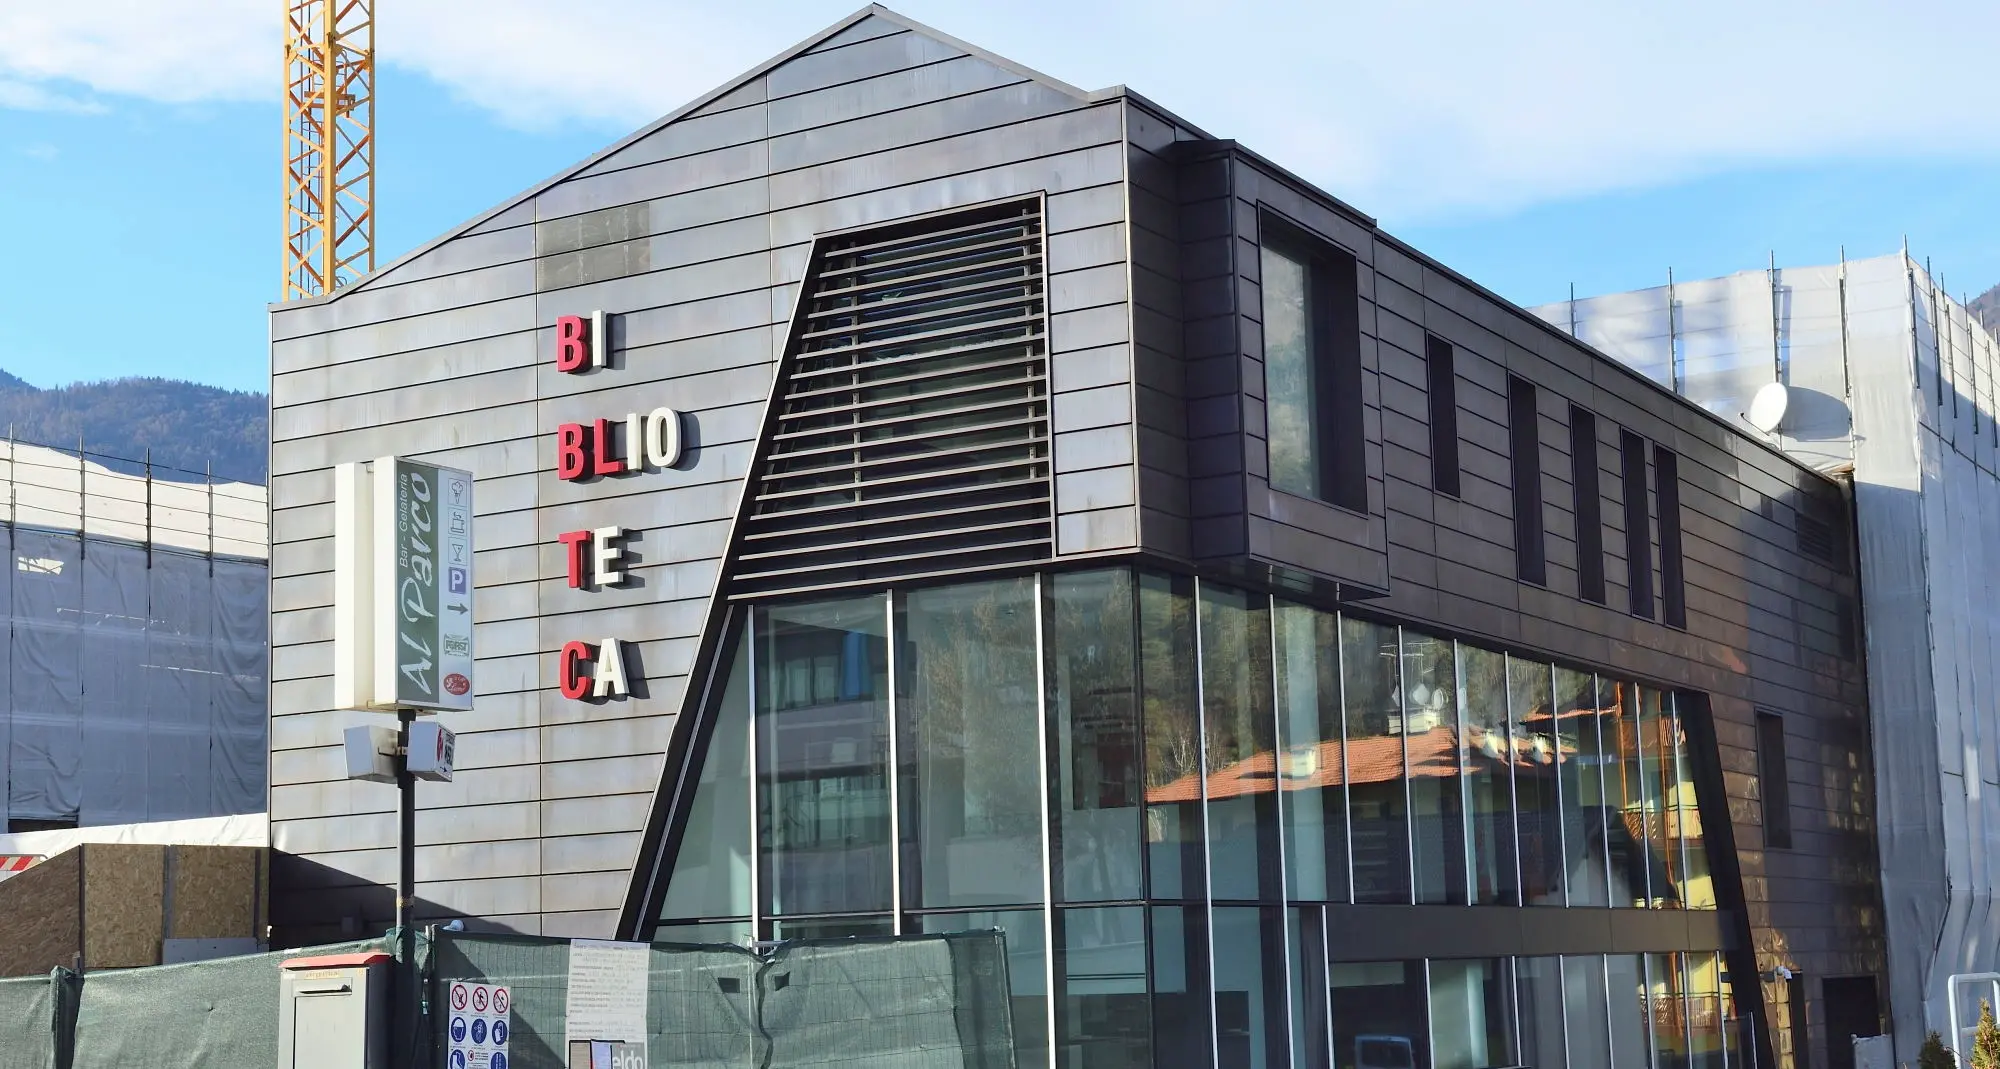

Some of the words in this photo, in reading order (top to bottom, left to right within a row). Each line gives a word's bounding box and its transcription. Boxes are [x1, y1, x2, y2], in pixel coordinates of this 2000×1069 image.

[557, 309, 606, 372] BI
[558, 407, 681, 480] BLIO
[399, 473, 408, 532] Gelateria
[400, 543, 408, 568] Bar
[401, 472, 435, 623] Parco
[558, 526, 623, 588] TE
[452, 570, 464, 590] P
[400, 631, 432, 695] Al
[560, 638, 629, 699] CA
